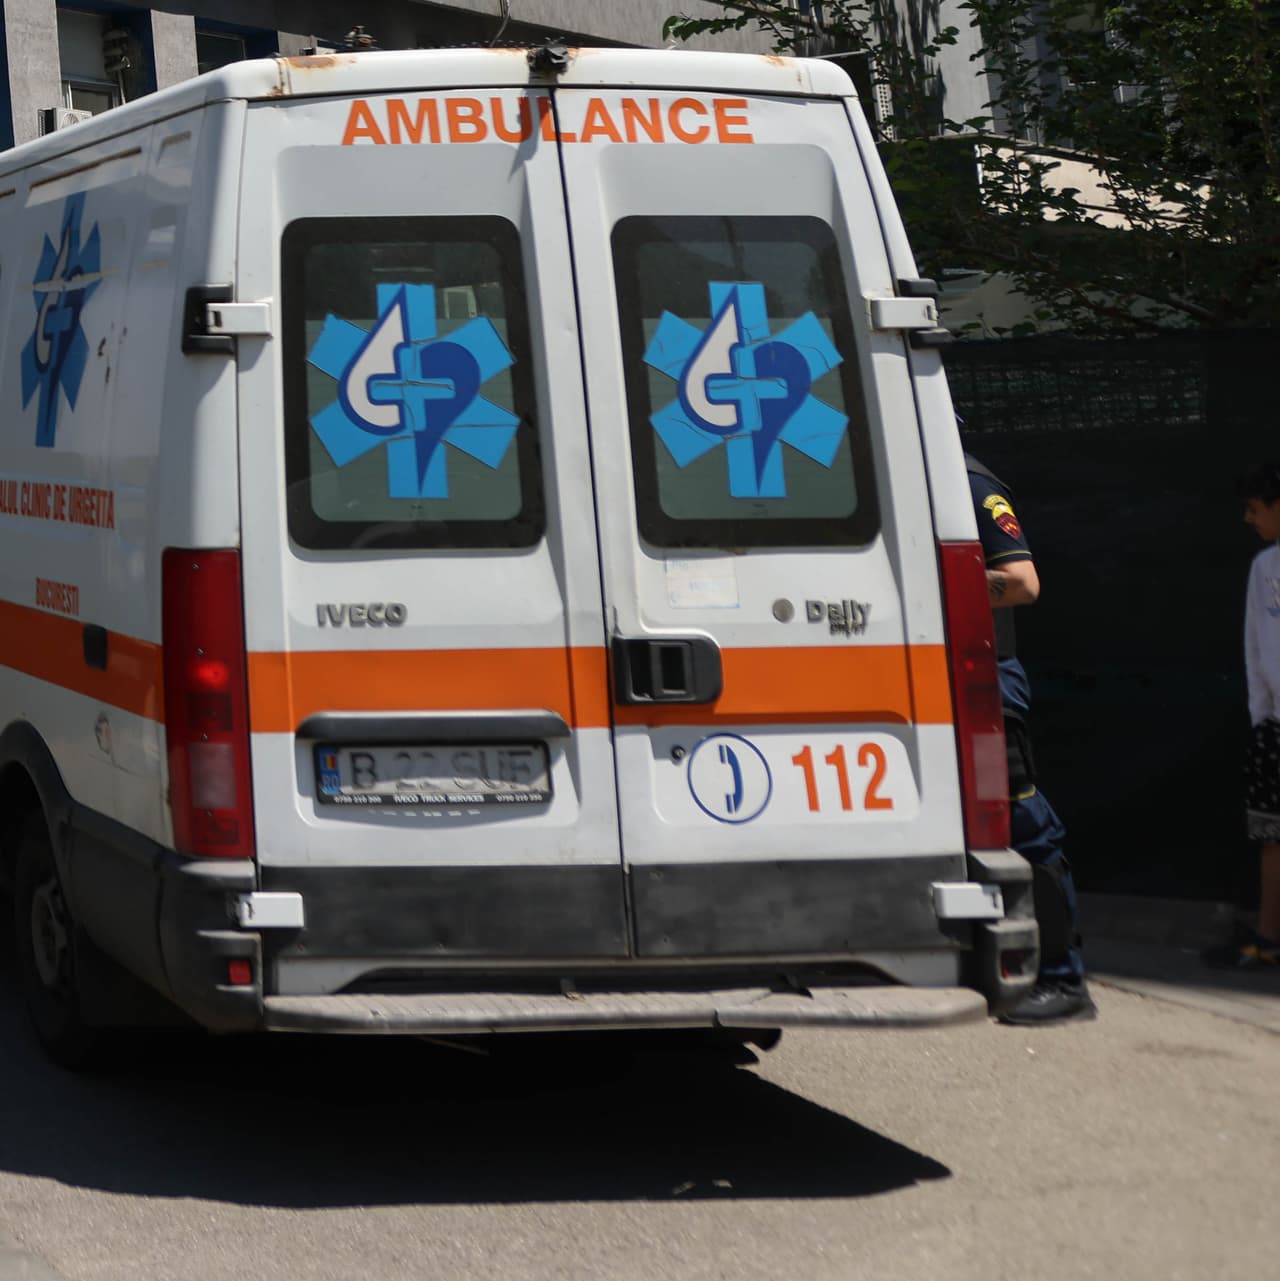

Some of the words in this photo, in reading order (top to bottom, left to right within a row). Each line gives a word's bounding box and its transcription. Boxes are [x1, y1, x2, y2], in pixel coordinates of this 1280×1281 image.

[342, 96, 754, 145] AMBULANCE
[21, 480, 51, 520] CLINIC
[53, 483, 67, 522] DE
[34, 577, 80, 617] BUCURESTI
[316, 602, 408, 628] IVECO
[792, 742, 893, 811] 112
